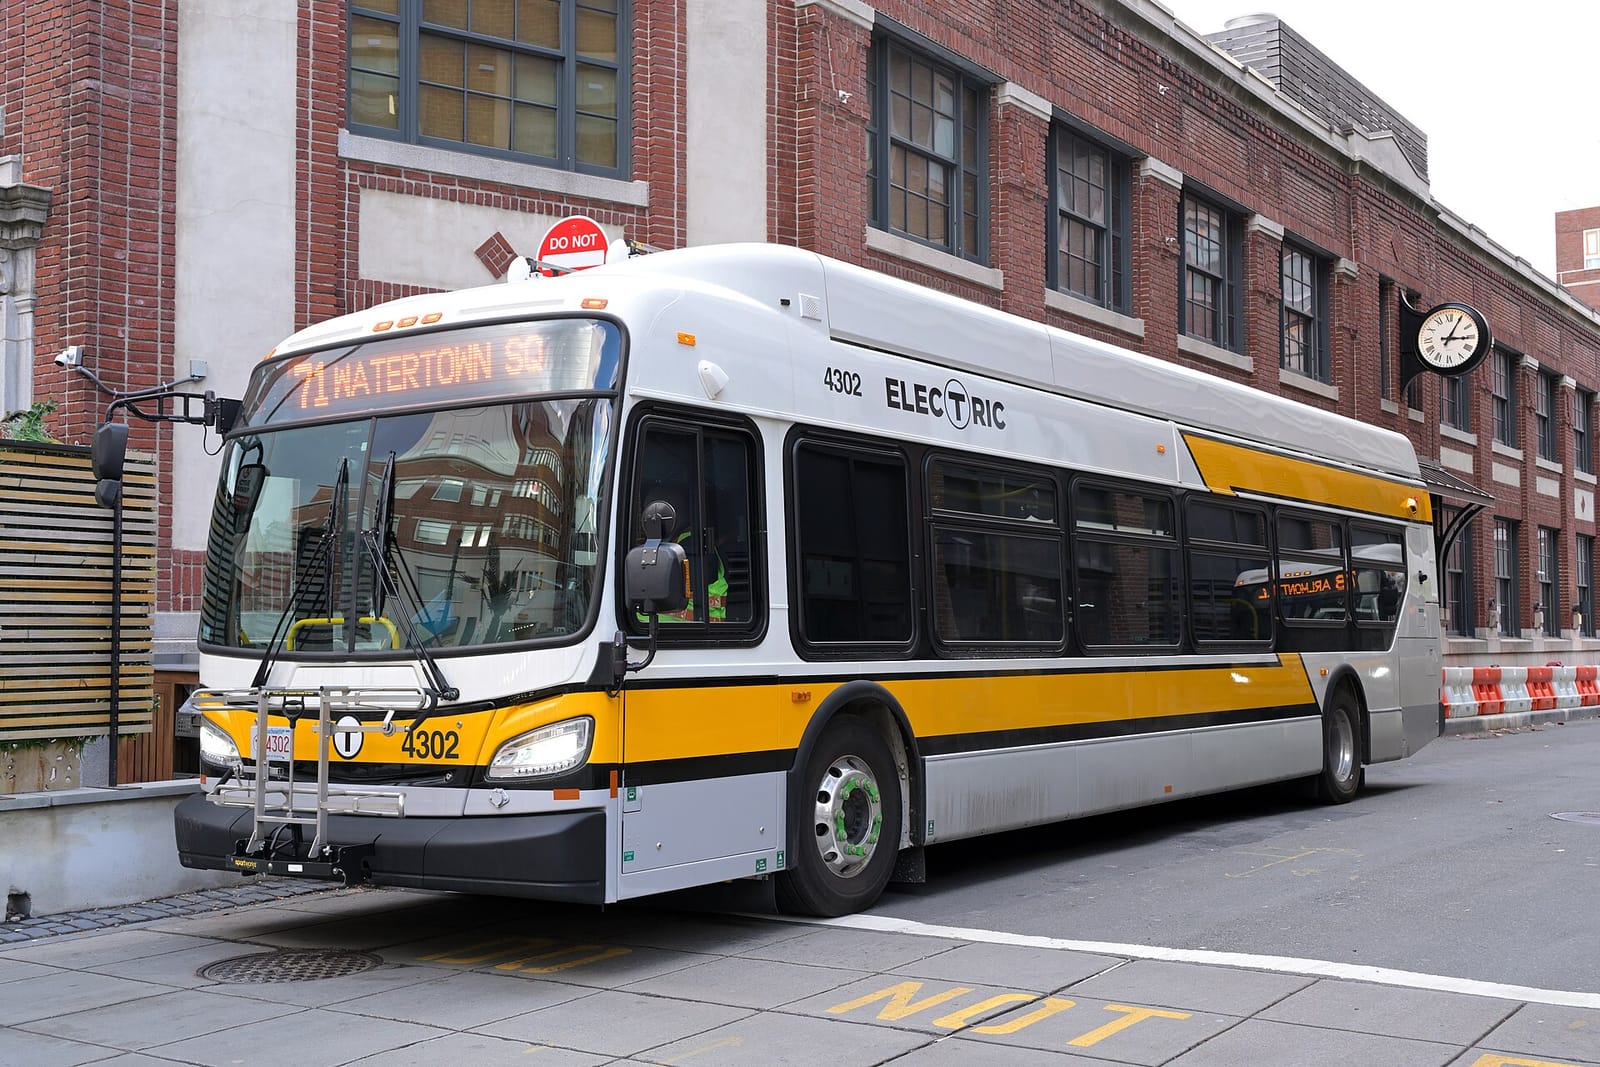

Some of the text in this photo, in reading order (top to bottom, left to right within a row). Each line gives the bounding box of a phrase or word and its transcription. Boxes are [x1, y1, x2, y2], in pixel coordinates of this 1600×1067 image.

[549, 233, 598, 250] DO NOT
[293, 334, 544, 409] 71 WATERTOWN SQ
[823, 366, 863, 397] 4302
[885, 376, 1006, 430] ELECTRIC
[266, 735, 290, 753] 4302
[401, 730, 459, 760] 4302
[824, 980, 1193, 1048] NOT
